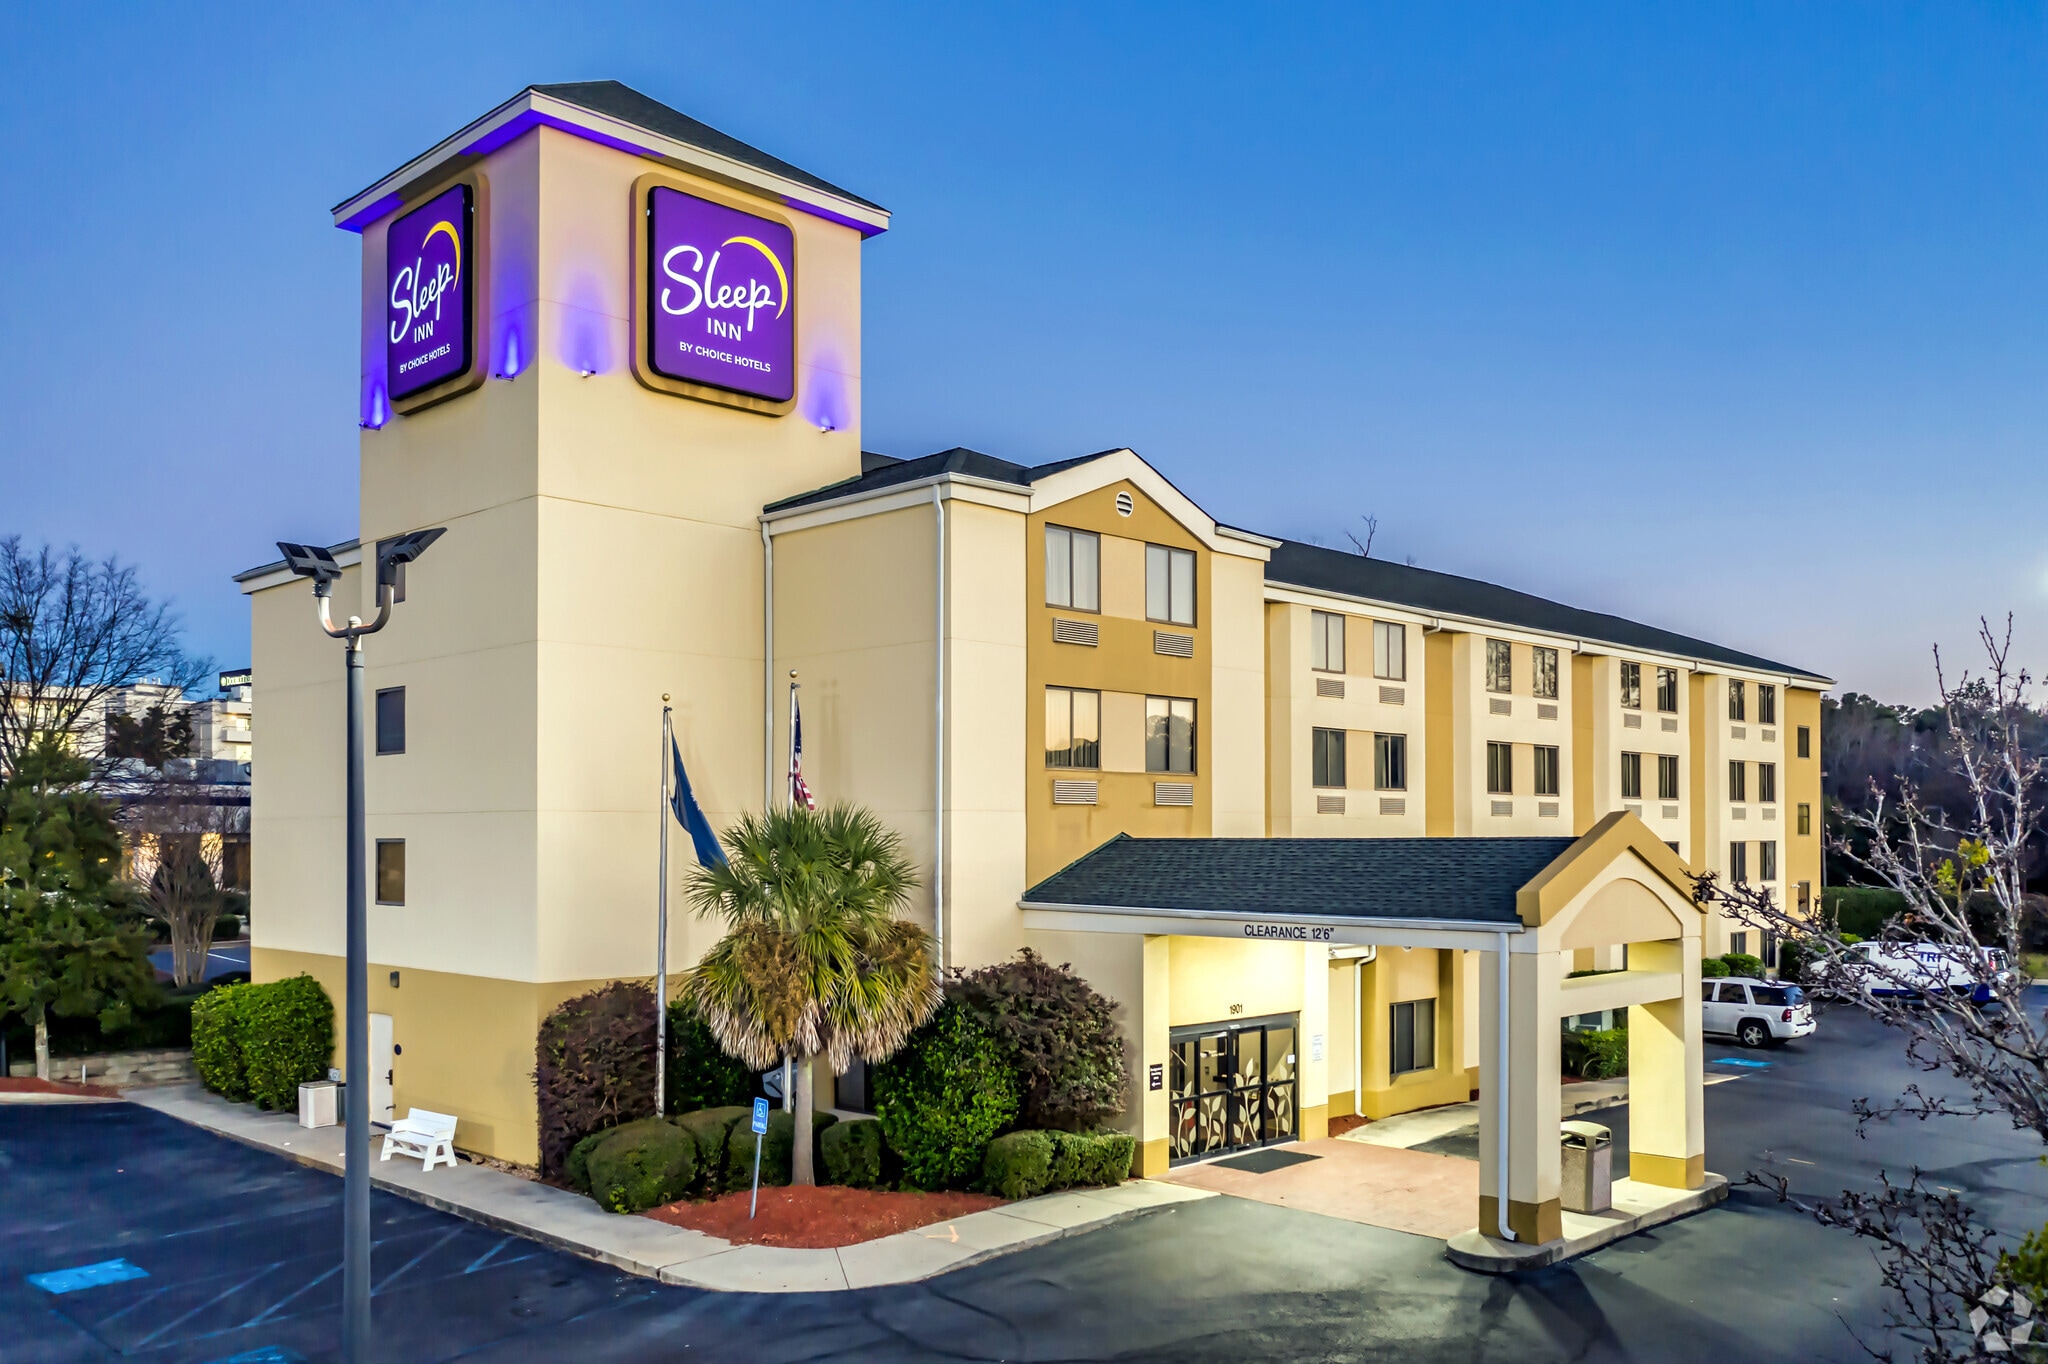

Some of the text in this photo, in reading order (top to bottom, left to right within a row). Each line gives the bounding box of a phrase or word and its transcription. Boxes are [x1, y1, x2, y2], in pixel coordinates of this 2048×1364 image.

[390, 256, 454, 344] Sleep
[661, 245, 777, 332] Sleep
[413, 320, 434, 344] INN
[707, 317, 742, 342] INN
[399, 343, 451, 374] BY CHOICE HOTELS
[679, 341, 771, 372] BY CHOICE HOTELS
[1244, 924, 1307, 939] CLEARANCE
[1229, 1003, 1243, 1015] 1901
